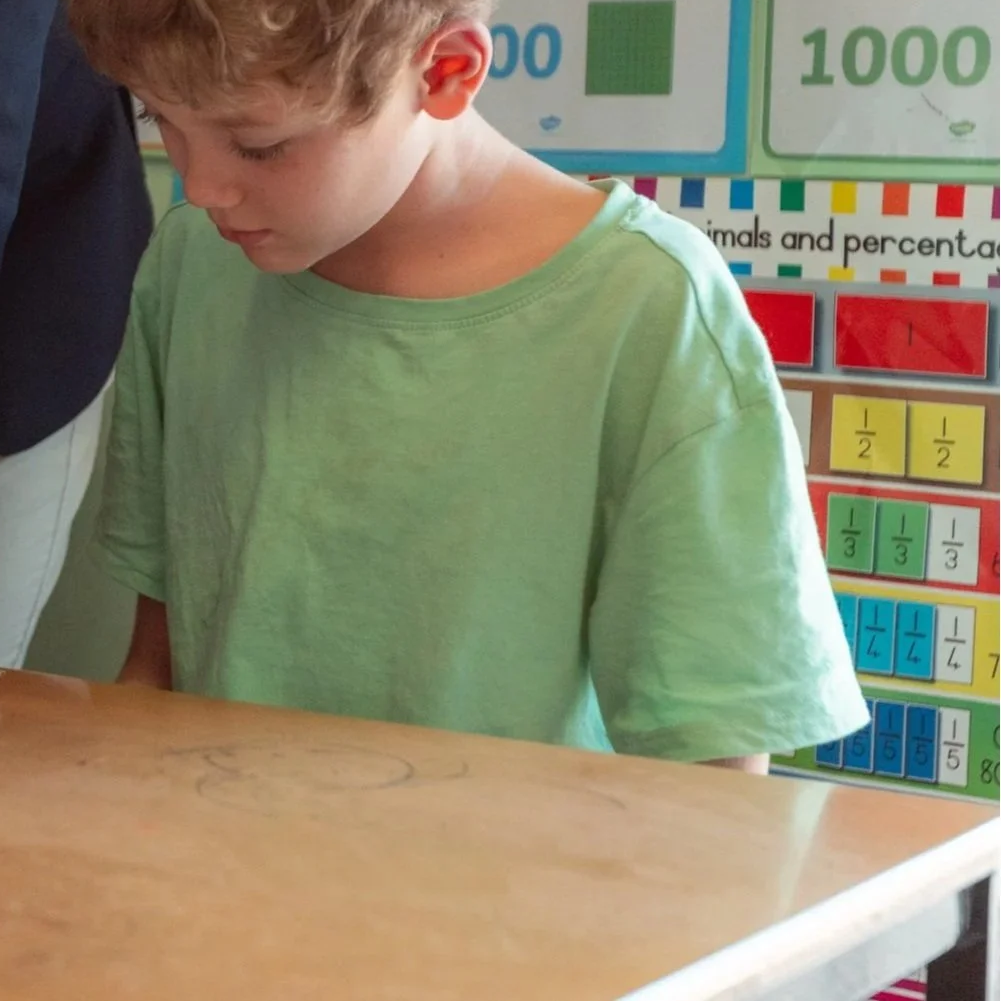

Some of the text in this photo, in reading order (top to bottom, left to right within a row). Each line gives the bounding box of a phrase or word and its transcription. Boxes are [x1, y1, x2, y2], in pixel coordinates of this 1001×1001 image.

[488, 22, 563, 80] 00
[801, 25, 992, 87] 1000
[704, 213, 1000, 275] imals and percenta
